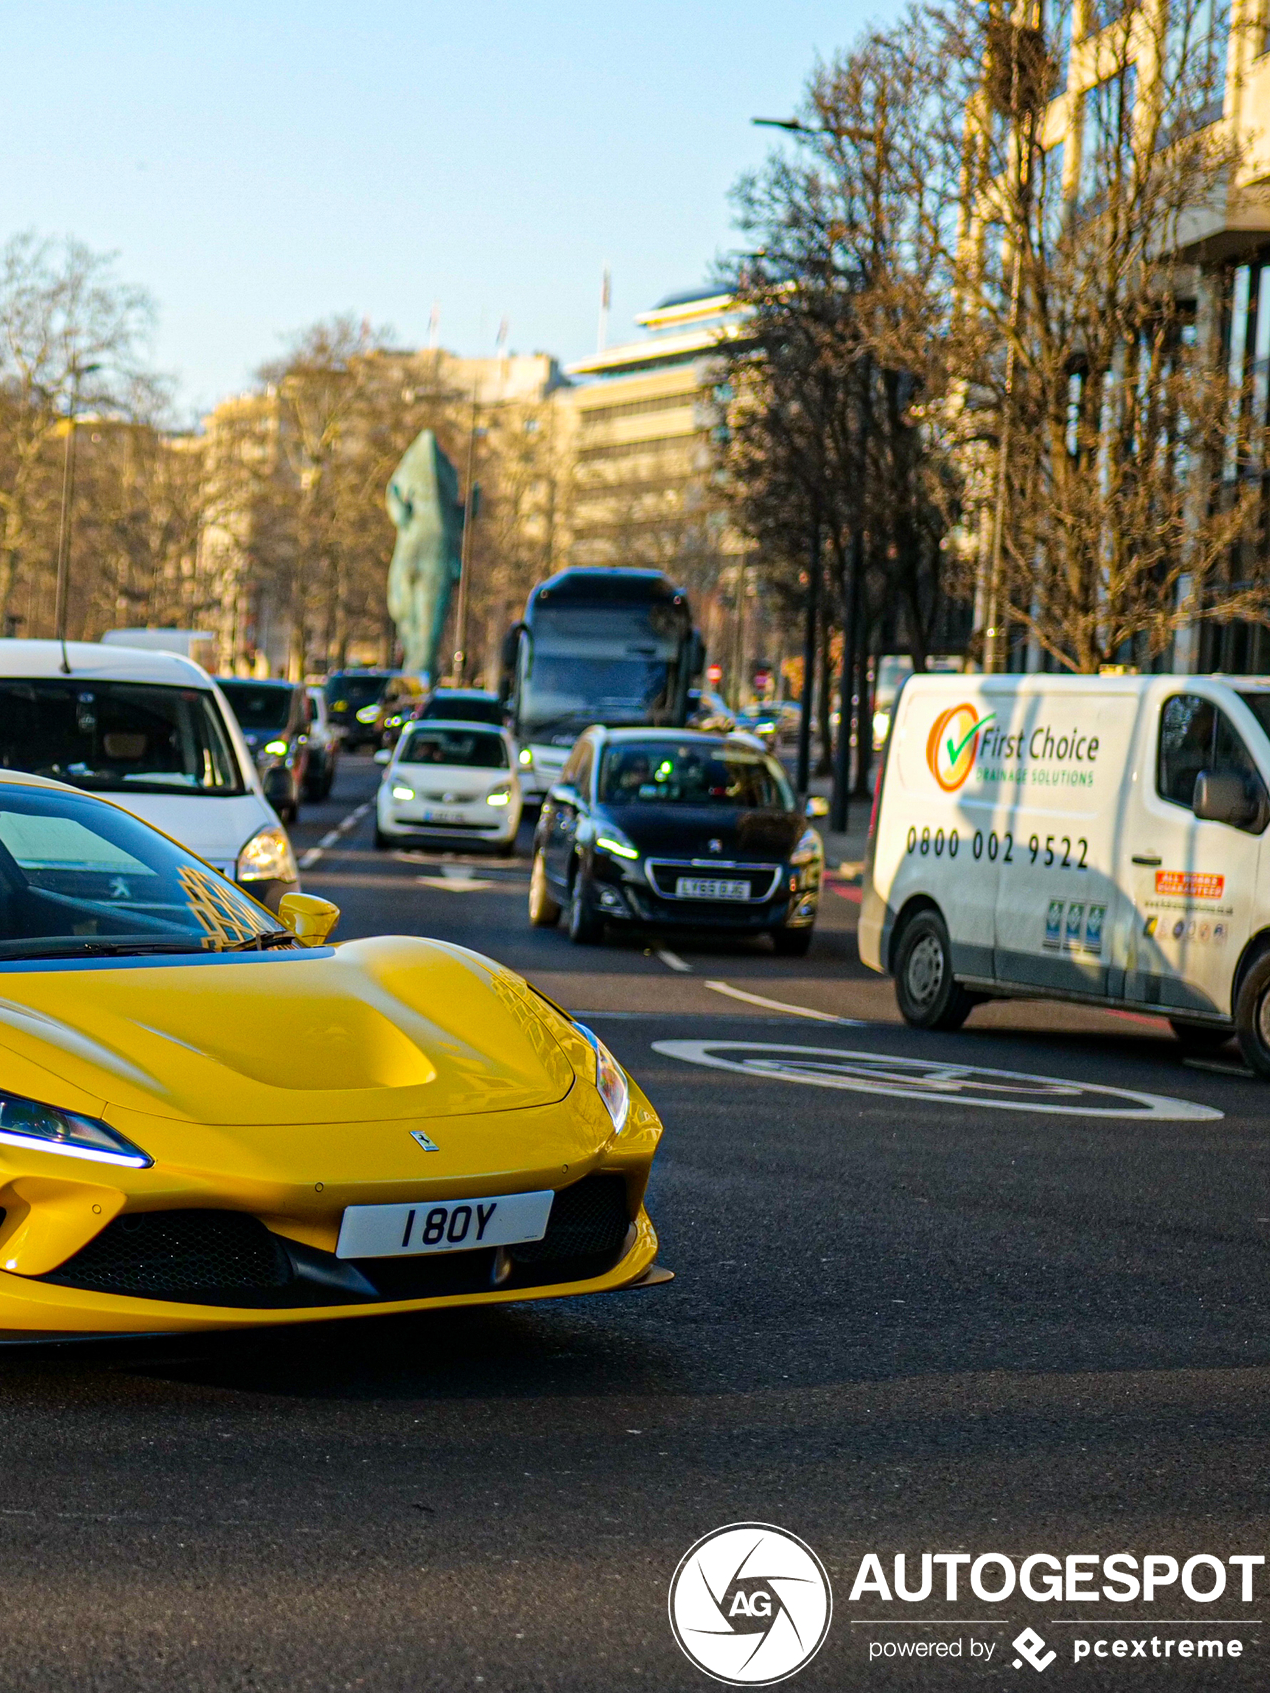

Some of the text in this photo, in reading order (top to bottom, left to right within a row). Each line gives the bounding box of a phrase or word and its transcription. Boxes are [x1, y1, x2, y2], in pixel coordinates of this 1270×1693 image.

[979, 725, 1100, 761] First Choice
[976, 767, 1094, 787] DRAINAGE SOLUTIONS
[907, 825, 1089, 869] 0800 002 9522
